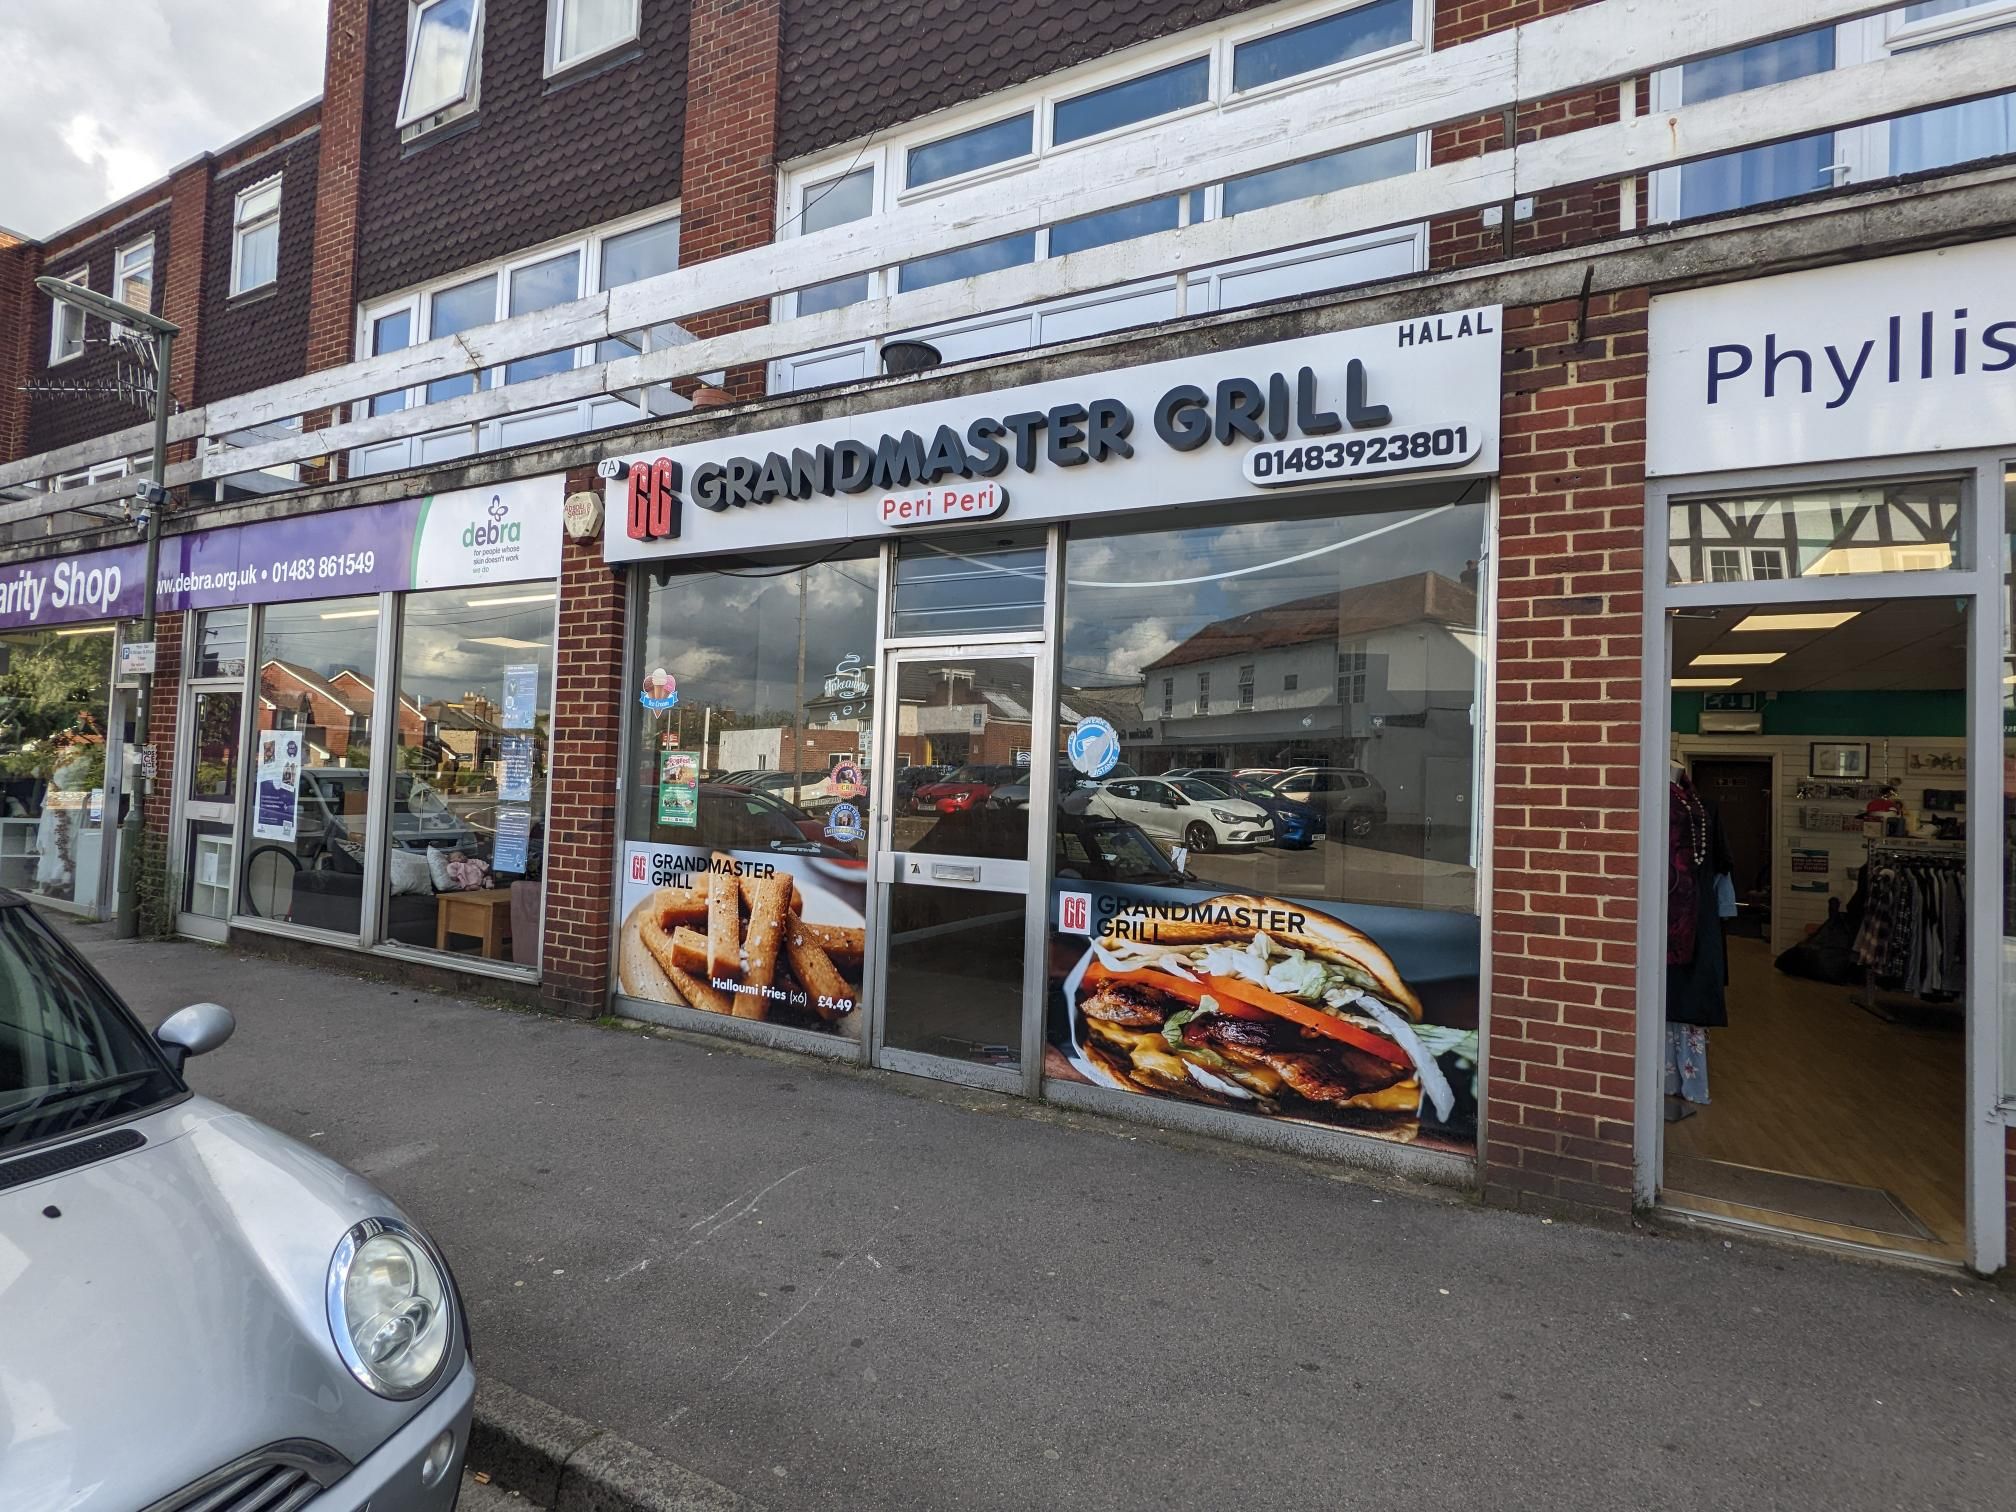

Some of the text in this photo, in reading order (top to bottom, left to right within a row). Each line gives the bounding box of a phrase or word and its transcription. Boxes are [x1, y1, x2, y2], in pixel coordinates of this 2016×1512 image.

[1398, 311, 1494, 348] HALAL
[1707, 308, 2016, 409] Phyllis
[690, 358, 1393, 513] GRANDMASTER GRILL
[1252, 425, 1469, 478] 01483923801
[601, 460, 617, 475] 7A
[883, 484, 994, 520] Peri Peri
[462, 519, 521, 547] debra
[473, 545, 520, 556] for people whose
[156, 550, 375, 595] ww.debra.org.uk 01483 861549
[473, 554, 519, 565] skin doesn't work
[52, 560, 122, 614] Shop
[651, 871, 693, 890] GRILL
[652, 853, 775, 880] GRANDMASTER
[1096, 917, 1167, 946] GRILL
[1097, 894, 1306, 934] GRANDMASTER
[712, 977, 852, 1012] Halloumi Fries (x6) £4.49
